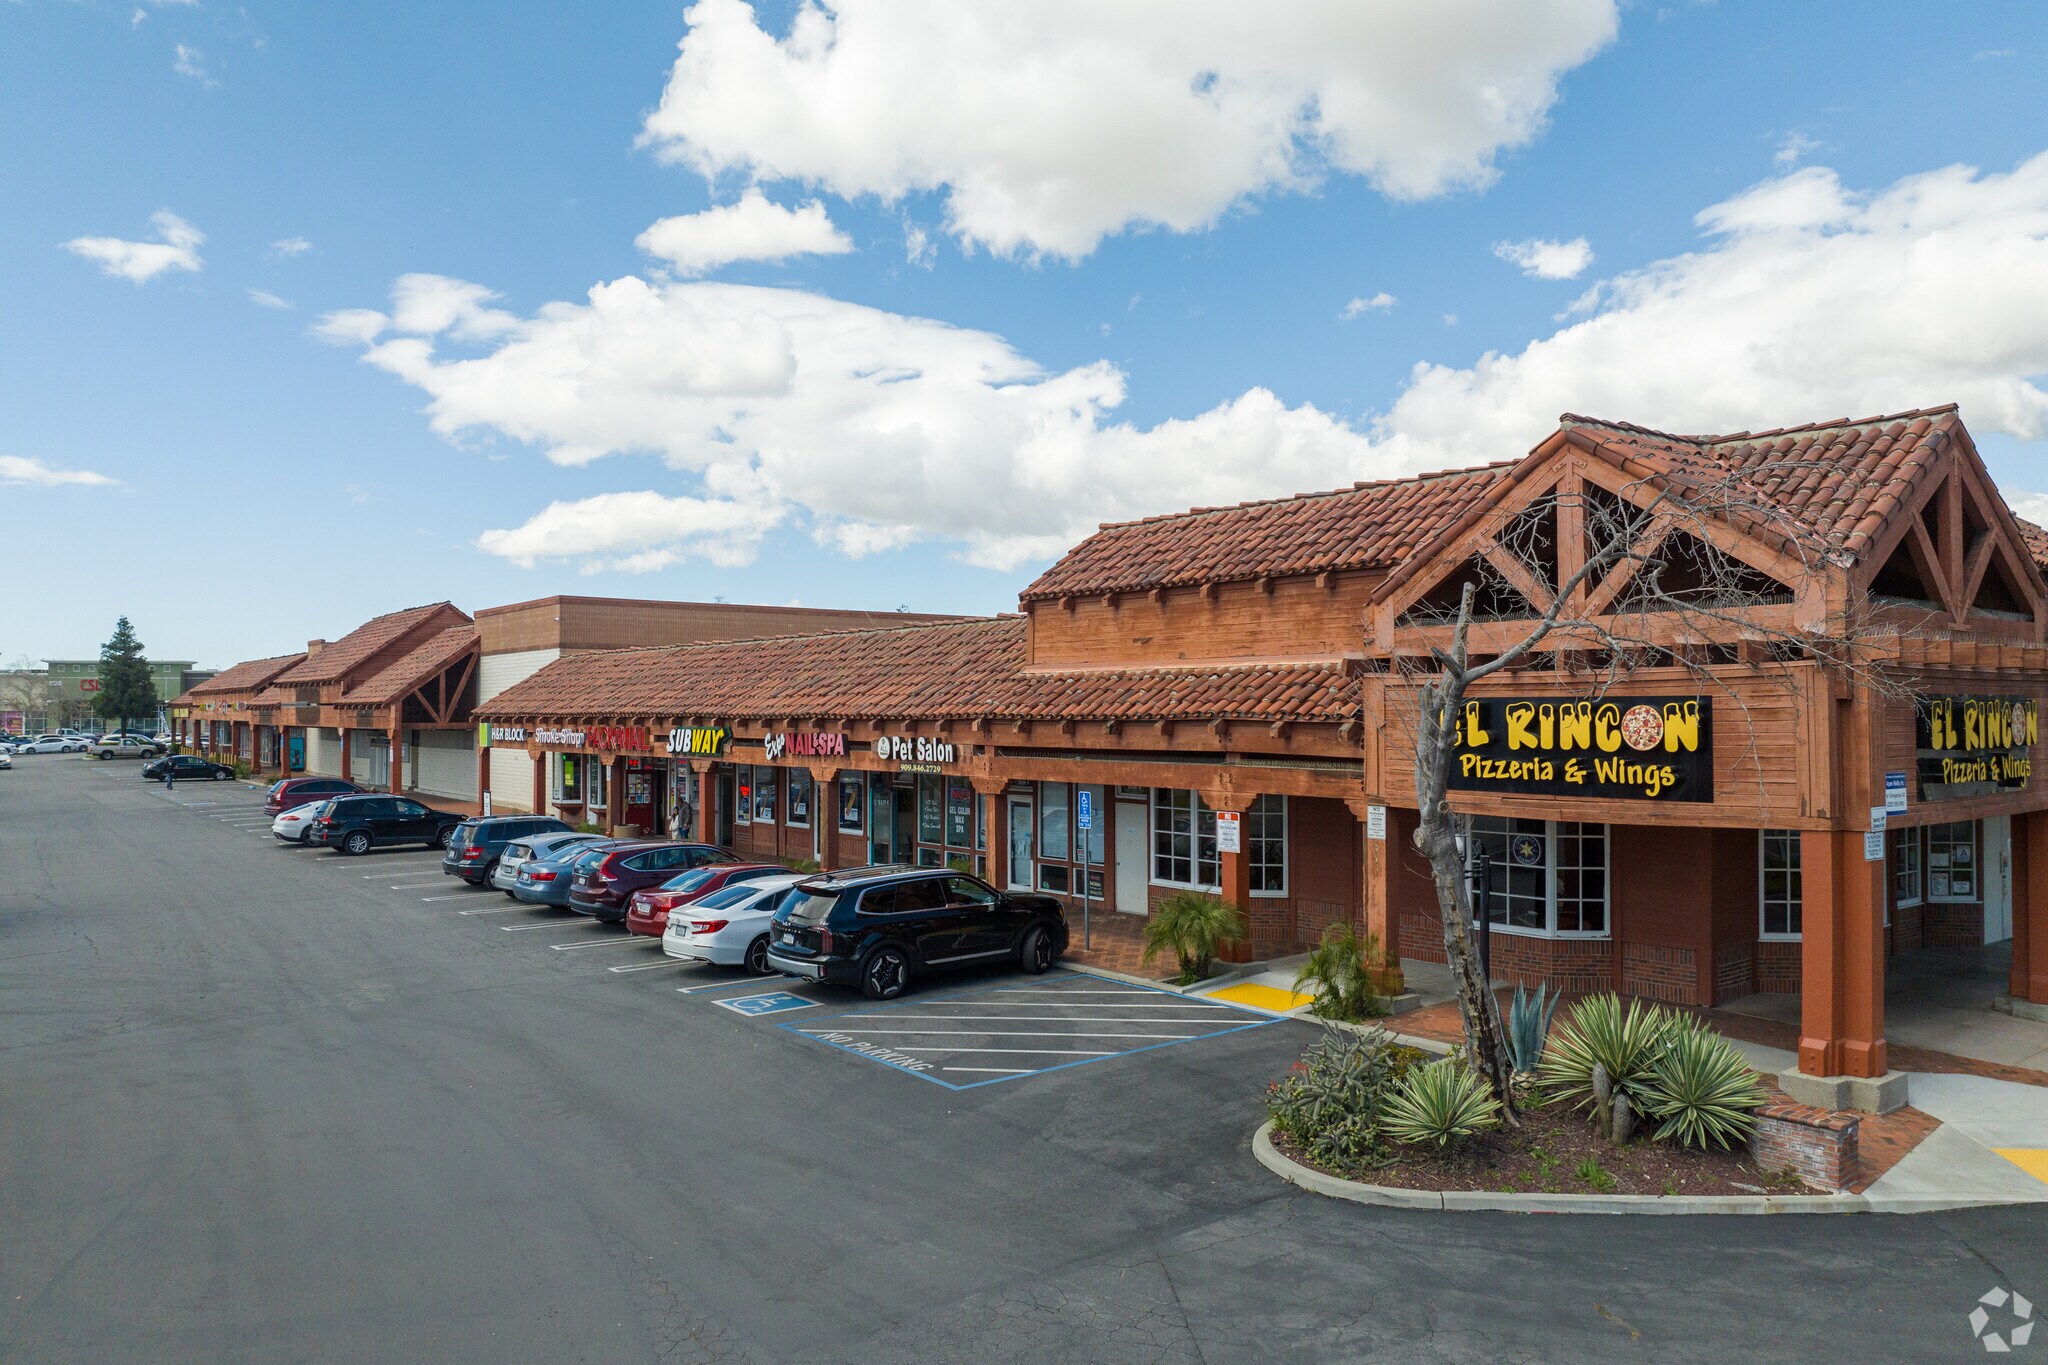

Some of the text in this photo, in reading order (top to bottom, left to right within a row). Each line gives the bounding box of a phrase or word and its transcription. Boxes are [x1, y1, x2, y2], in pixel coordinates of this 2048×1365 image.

[491, 728, 525, 741] H&R BLOCK
[535, 728, 585, 749] Smoke Shop
[1932, 698, 2038, 751] EL RINCON
[666, 728, 724, 754] SUBWAY
[892, 736, 953, 762] Pet Salon
[1459, 753, 1676, 797] Pizzeria & Wings
[1942, 754, 2031, 788] Pizzeria & Wings
[816, 1032, 934, 1071] NO PARKING
